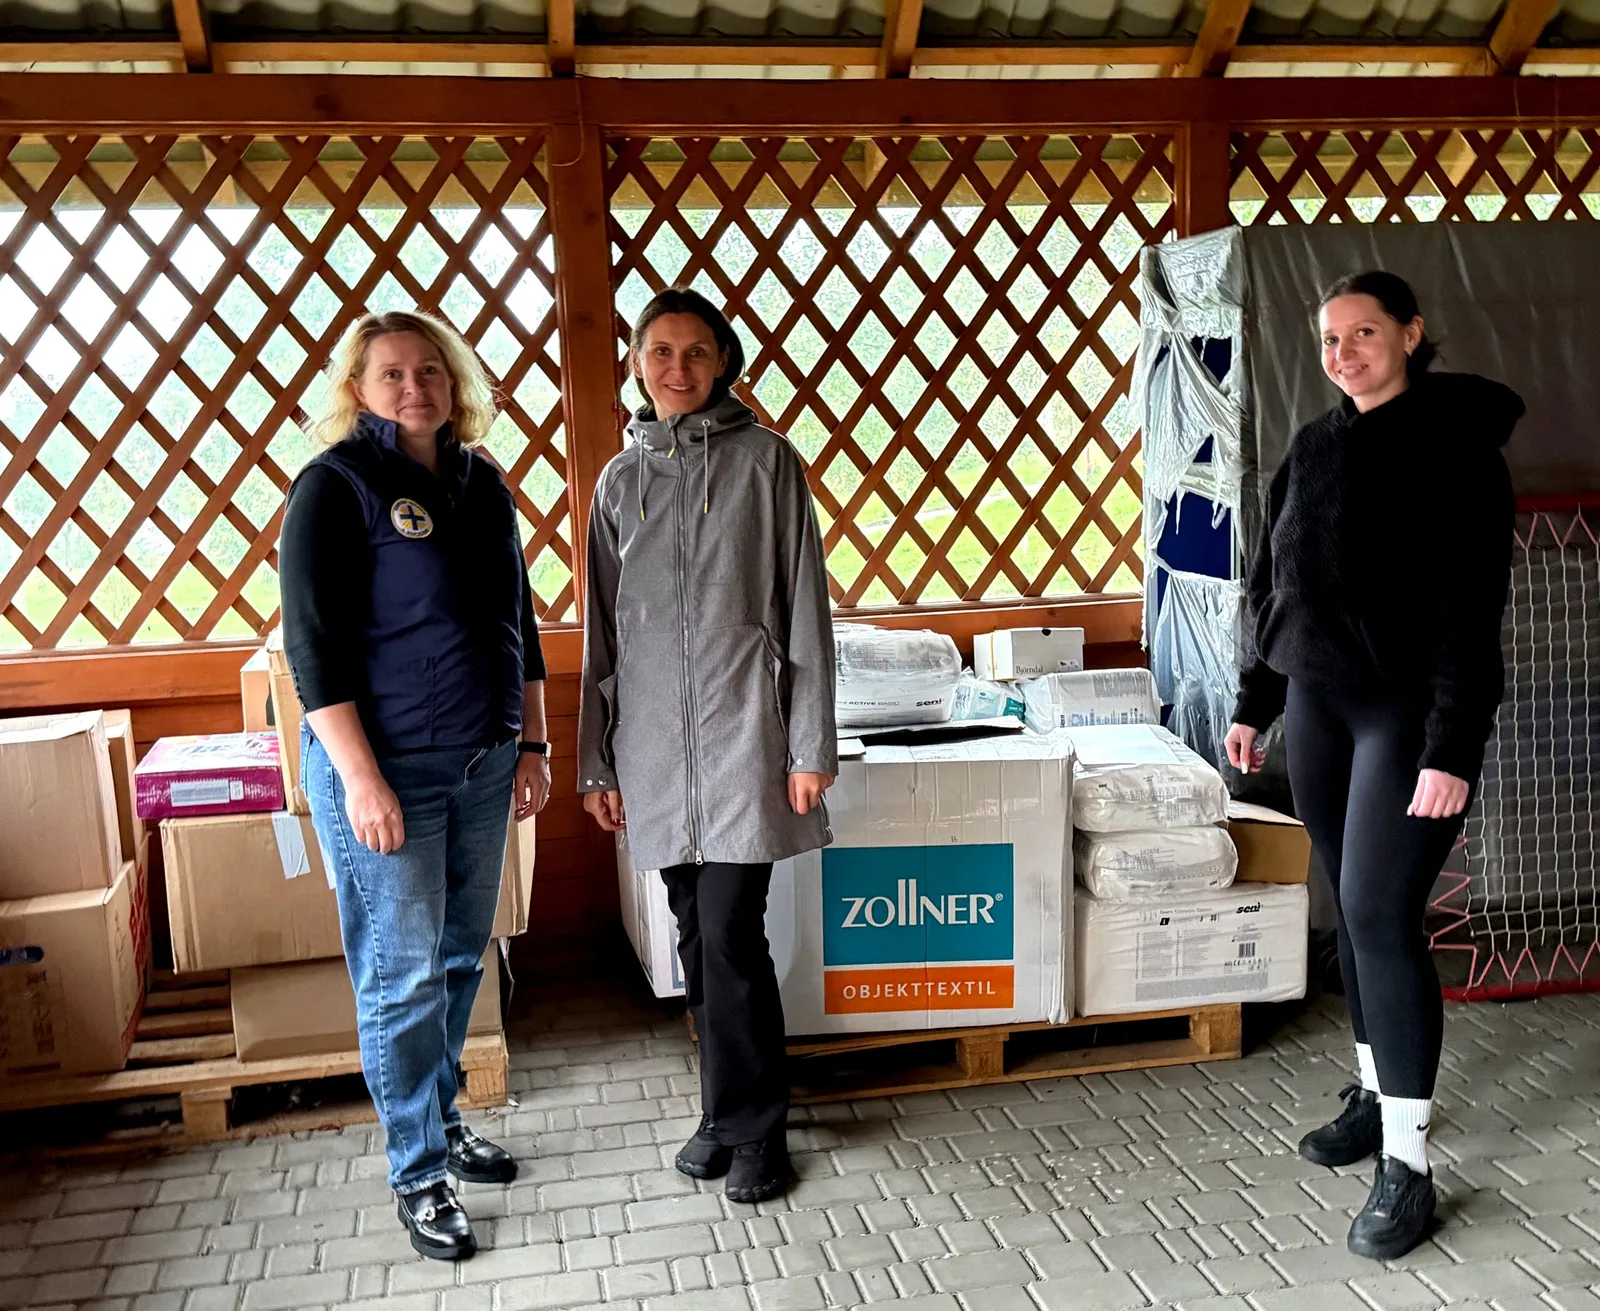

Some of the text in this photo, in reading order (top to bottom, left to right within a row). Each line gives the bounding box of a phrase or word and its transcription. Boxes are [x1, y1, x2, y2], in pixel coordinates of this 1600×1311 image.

[1016, 665, 1044, 674] Björndal
[916, 698, 942, 707] seni
[1236, 902, 1261, 914] seni
[843, 981, 996, 999] OBJEKTTEXTIL
